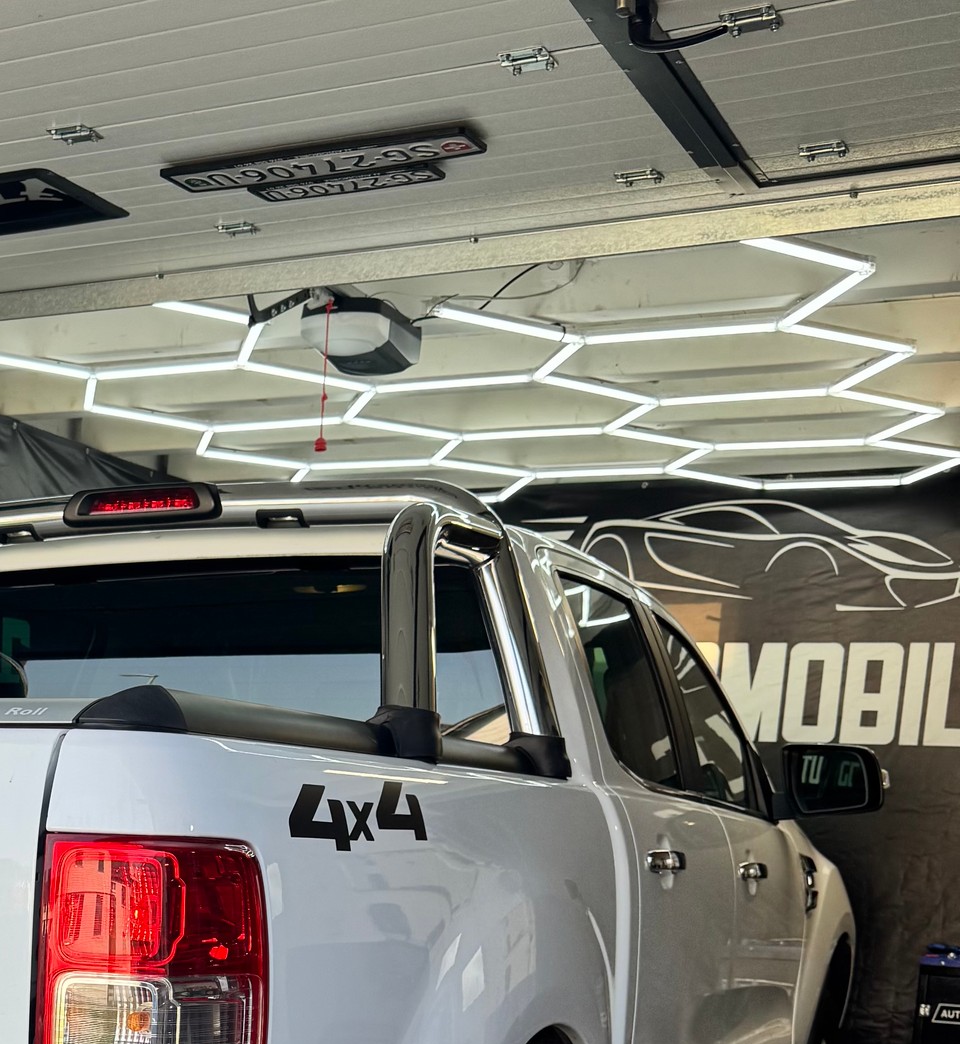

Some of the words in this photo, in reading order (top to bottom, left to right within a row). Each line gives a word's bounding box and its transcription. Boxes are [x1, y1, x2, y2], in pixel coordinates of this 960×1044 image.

[4, 707, 49, 716] Roll
[695, 641, 960, 747] MOBIL
[289, 780, 428, 852] 4x4
